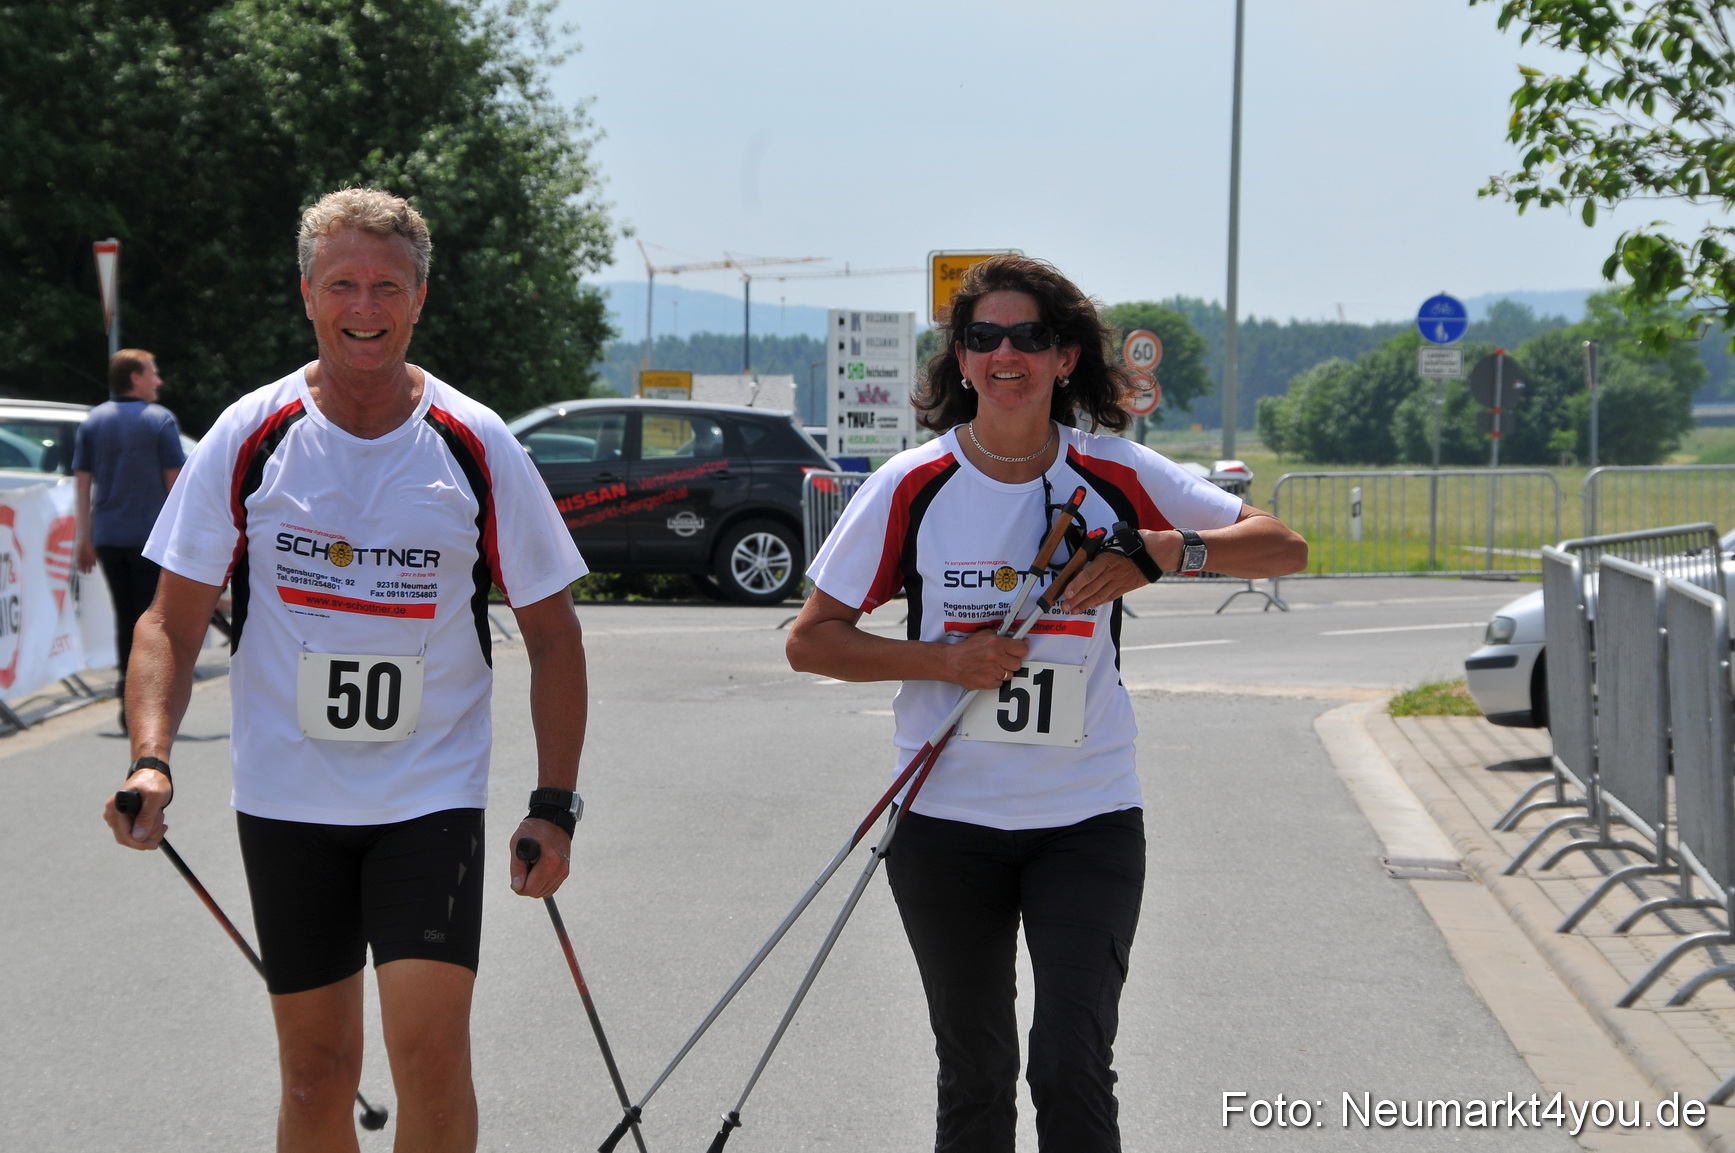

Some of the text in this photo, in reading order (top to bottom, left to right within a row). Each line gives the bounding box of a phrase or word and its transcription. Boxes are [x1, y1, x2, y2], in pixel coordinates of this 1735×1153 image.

[1132, 342, 1153, 361] 60
[847, 411, 875, 429] THULE
[555, 482, 628, 513] NISSAN
[276, 563, 355, 587] Regensburger Str. 92
[276, 573, 341, 590] Tel. 09181/254801
[370, 590, 438, 599] Fax 09181/254803
[376, 581, 438, 590] 92318 Neumarkt
[306, 595, 406, 615] www.sv-schottner.de
[943, 602, 997, 611] Regensburger
[944, 610, 957, 618] Tel.
[327, 659, 402, 731] 50
[996, 666, 1055, 734] 51
